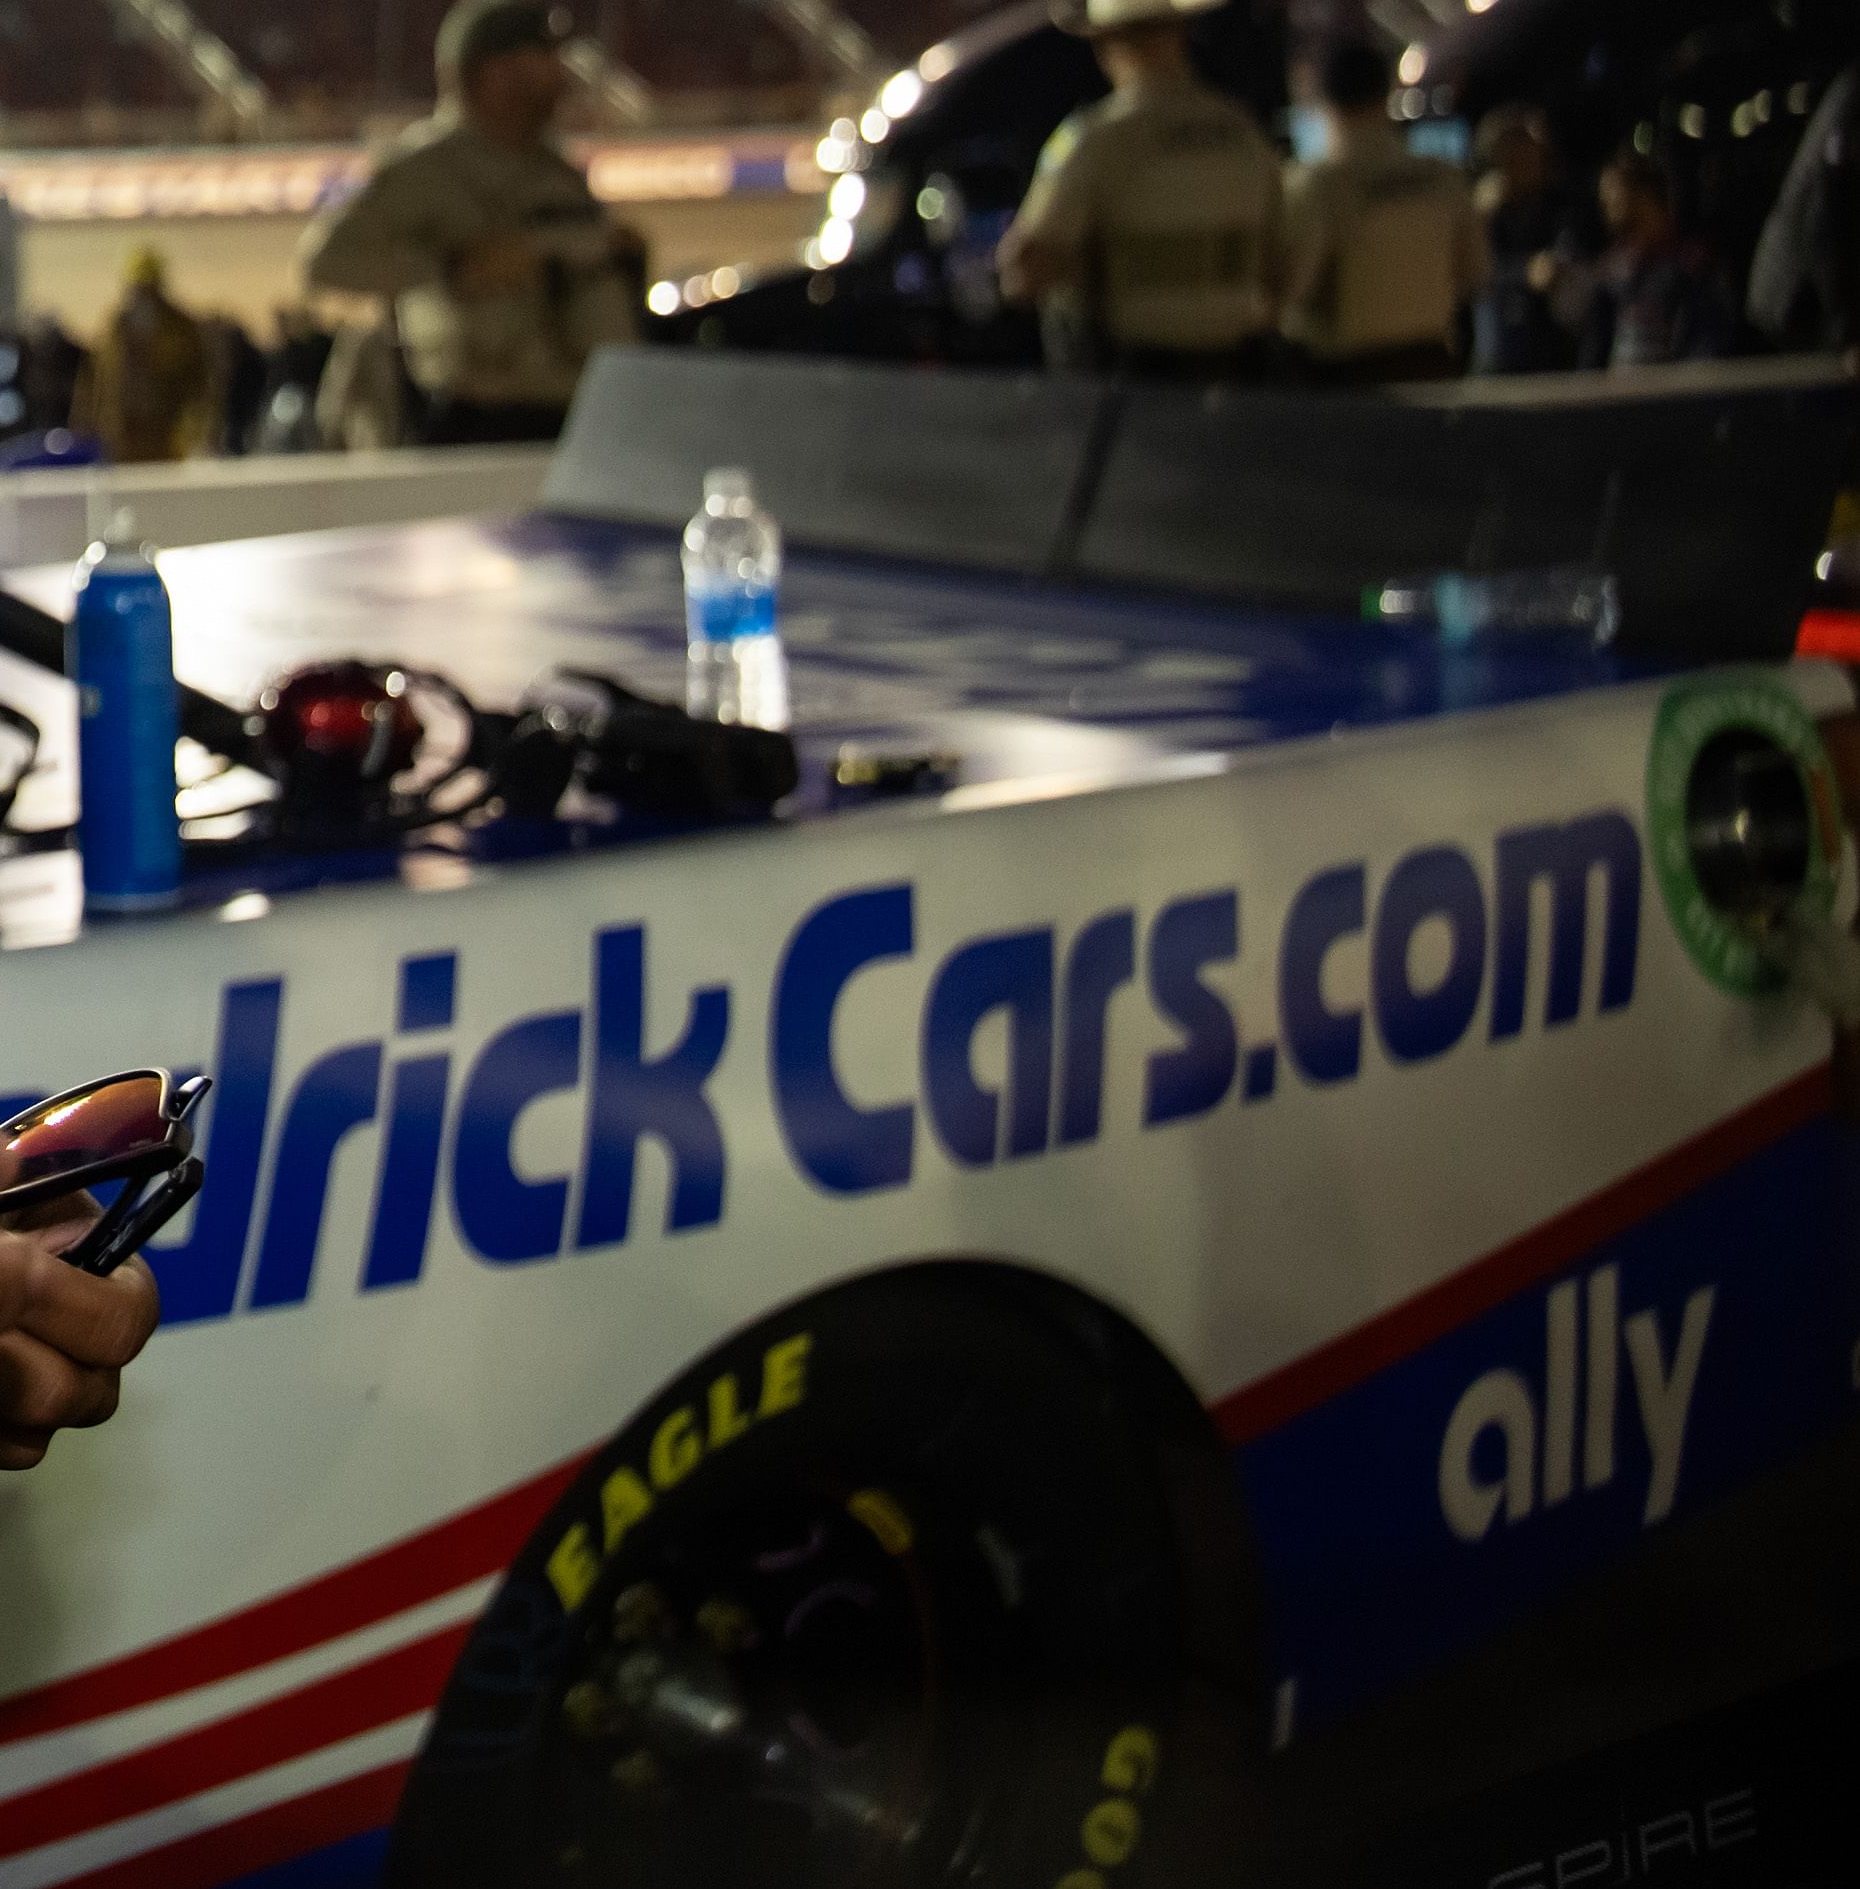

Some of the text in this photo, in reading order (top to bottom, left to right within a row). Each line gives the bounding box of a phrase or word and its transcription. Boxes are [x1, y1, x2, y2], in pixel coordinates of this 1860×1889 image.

[767, 806, 1642, 1200] Cars.com
[546, 1331, 813, 1611] EAGLE
[1437, 1261, 1717, 1543] ally
